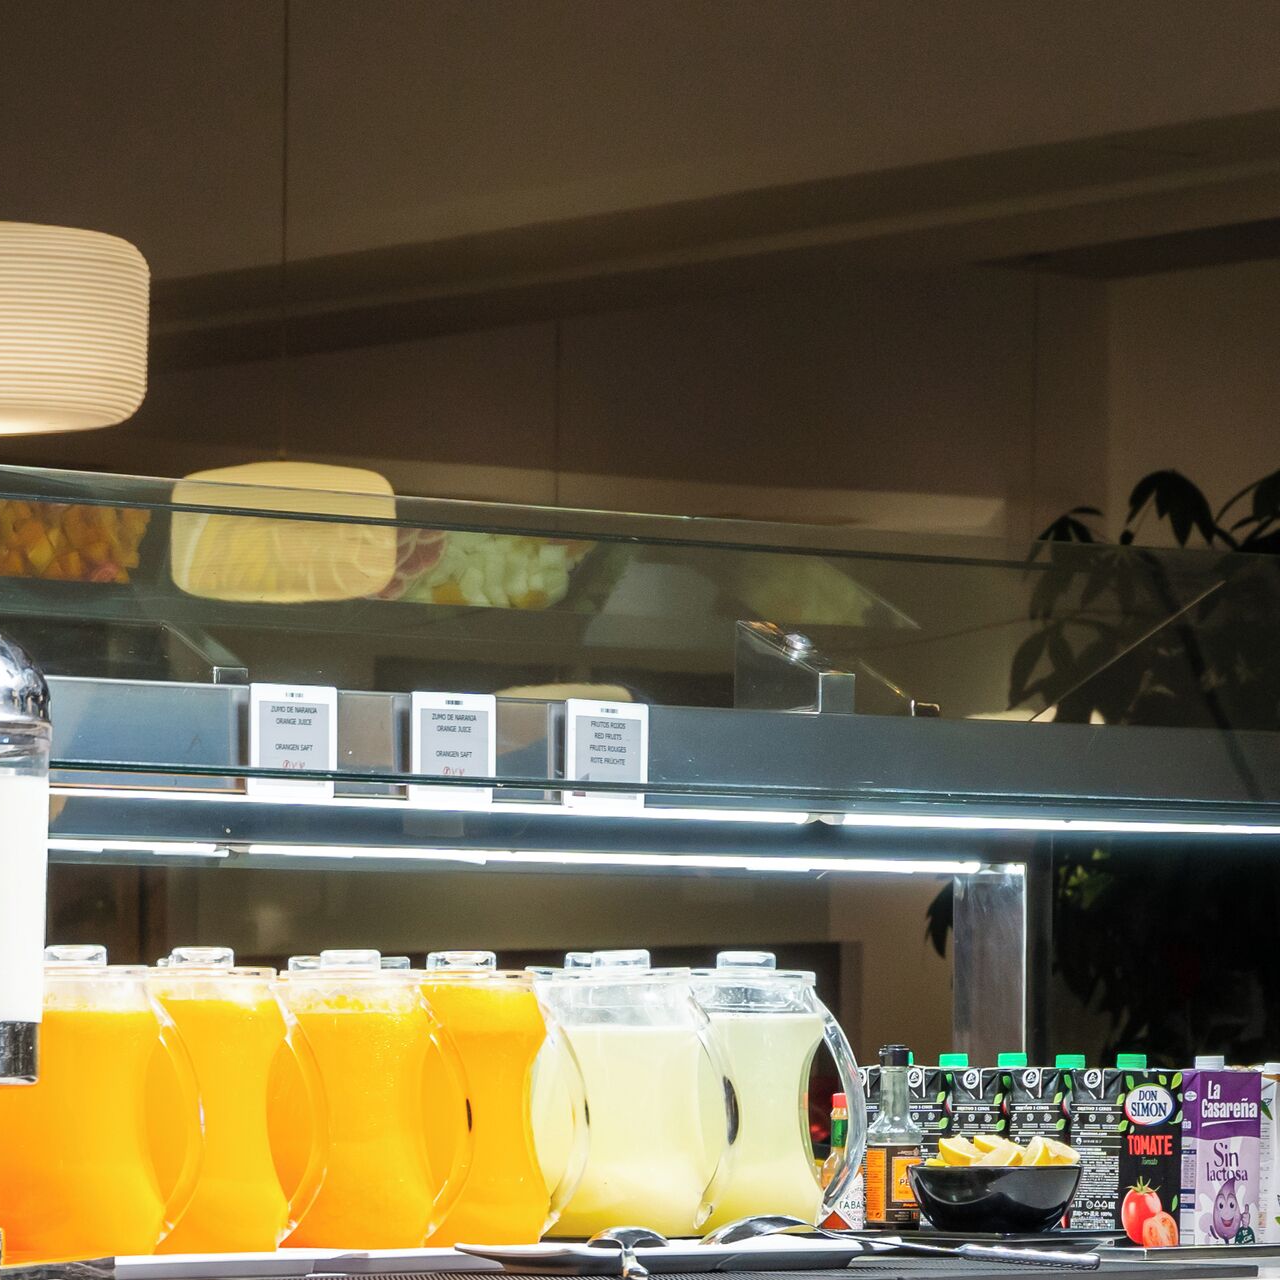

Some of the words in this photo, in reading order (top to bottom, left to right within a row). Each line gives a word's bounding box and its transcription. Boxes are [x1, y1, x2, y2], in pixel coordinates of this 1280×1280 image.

[1138, 1090, 1158, 1102] DON
[1207, 1080, 1221, 1100] La
[1131, 1102, 1167, 1117] SIMON
[1201, 1098, 1258, 1119] Casareña
[1127, 1134, 1173, 1156] TOMATE
[1213, 1142, 1239, 1168] Sin
[1206, 1162, 1248, 1182] lactosa
